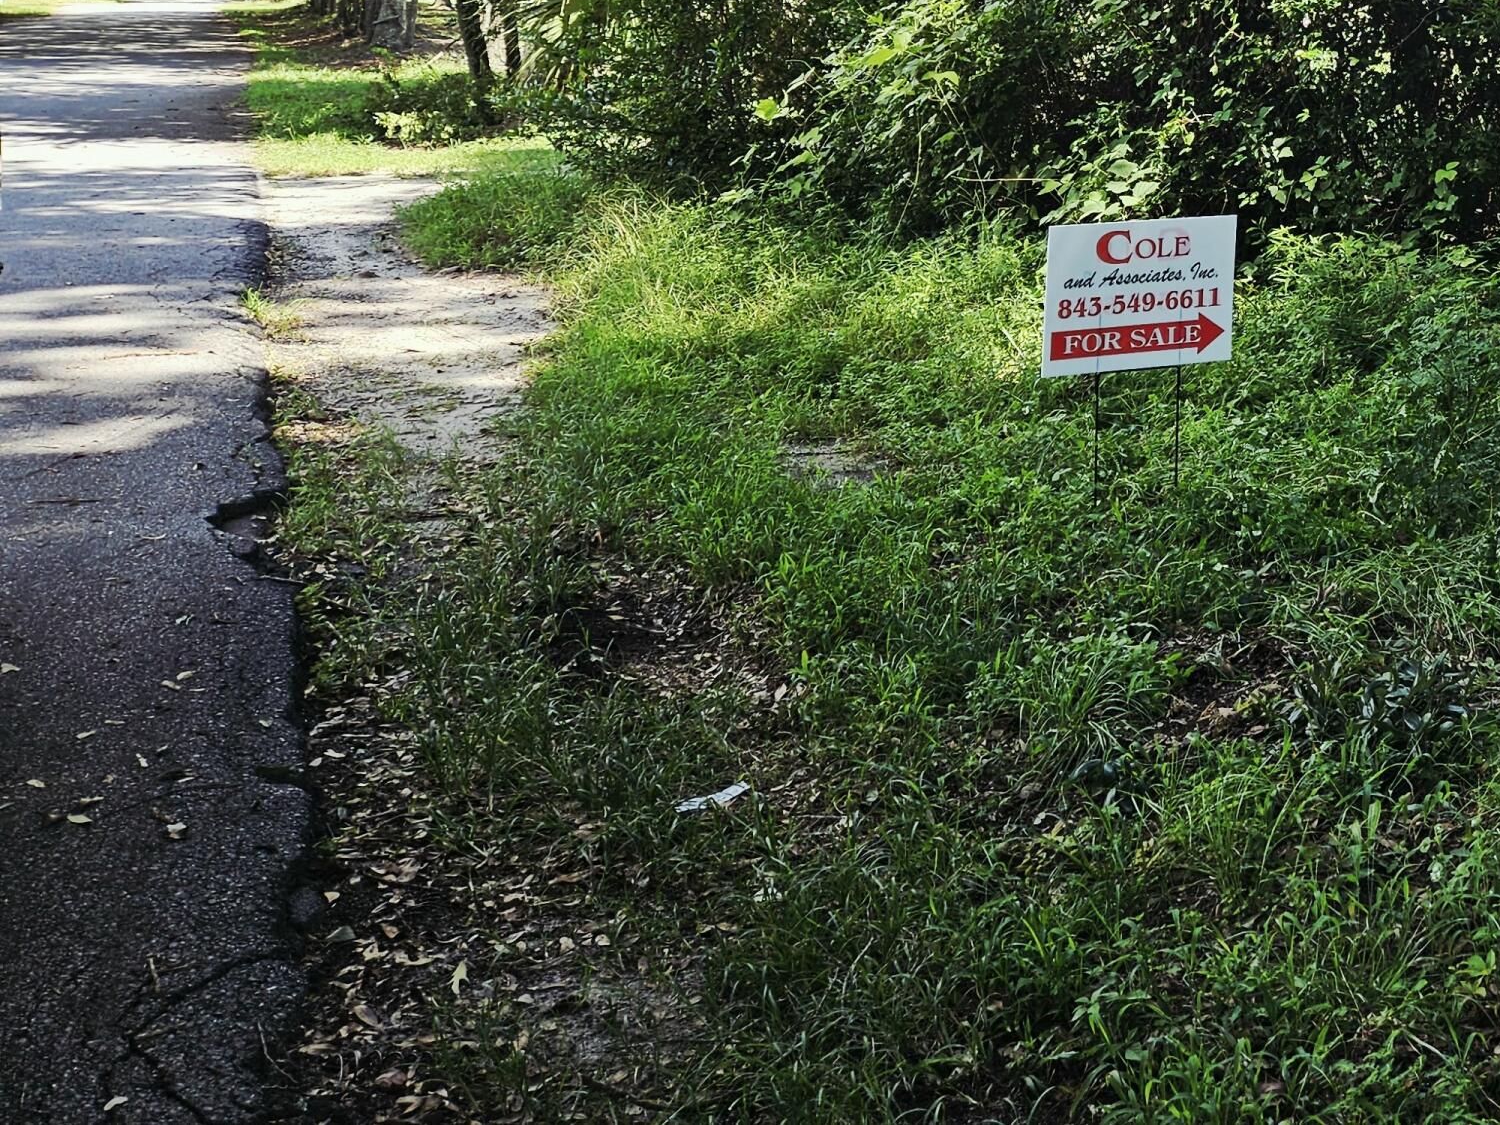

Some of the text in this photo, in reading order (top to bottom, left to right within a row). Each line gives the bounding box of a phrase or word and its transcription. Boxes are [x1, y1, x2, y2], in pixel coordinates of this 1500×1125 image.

[1096, 230, 1191, 265] COLE
[1063, 262, 1219, 289] and Associates, Inc.
[1057, 287, 1221, 319] 843-549-6611
[1063, 324, 1202, 355] FOR SALE
